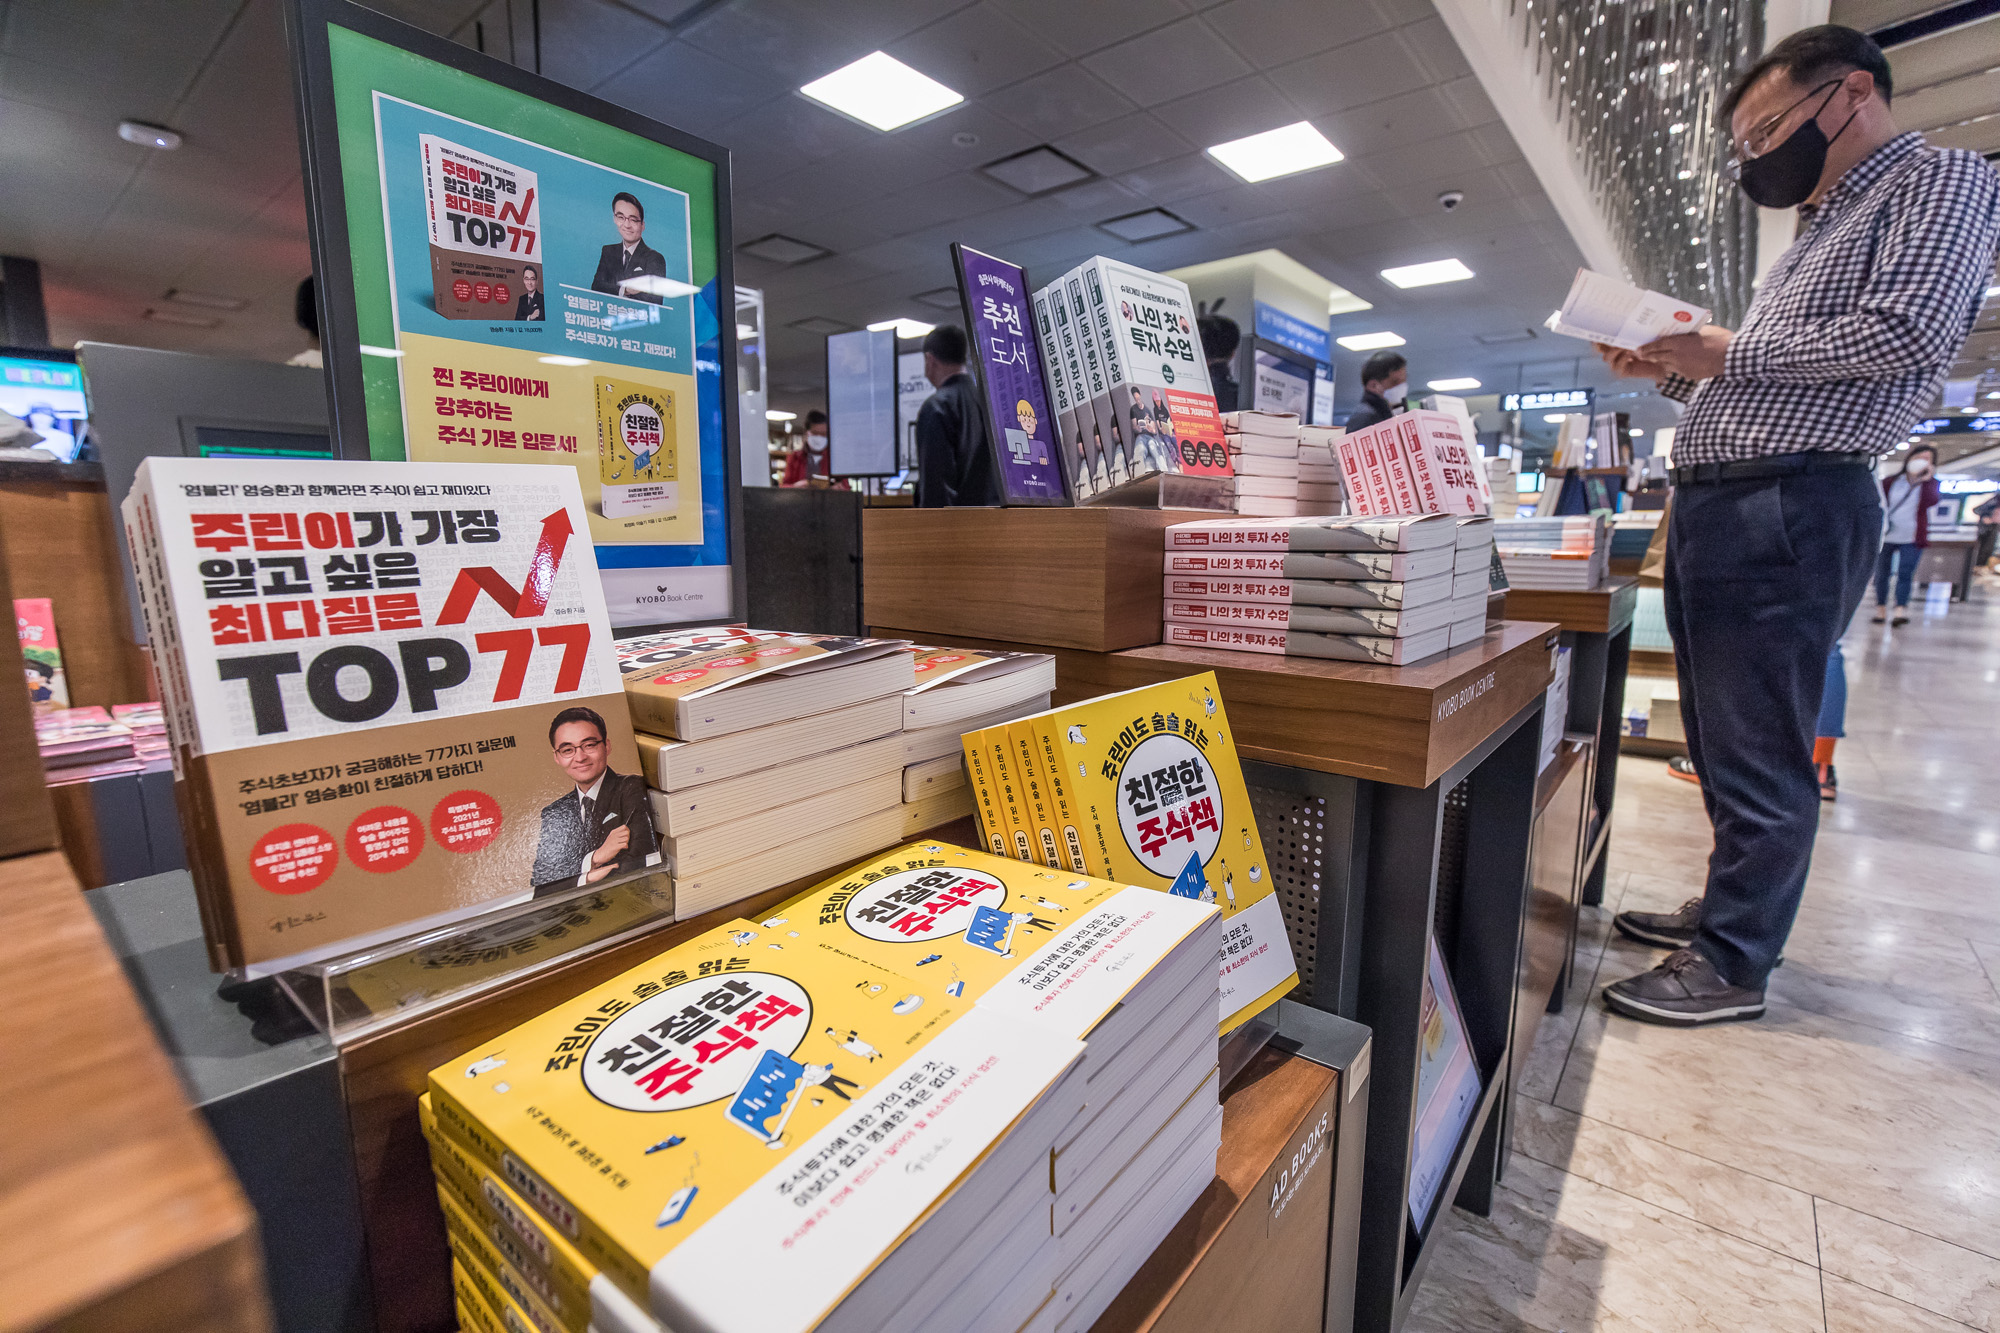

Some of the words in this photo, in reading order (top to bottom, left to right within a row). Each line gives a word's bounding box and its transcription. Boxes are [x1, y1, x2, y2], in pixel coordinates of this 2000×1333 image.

[442, 158, 493, 188] 주린이가
[495, 176, 517, 195] 가장
[443, 176, 470, 197] 알고
[472, 182, 496, 205] 싶은
[444, 193, 495, 219] 최다질문
[983, 296, 1023, 336] 추천
[1097, 306, 1109, 328] 나의
[1133, 303, 1163, 331] 나의
[1163, 311, 1180, 334] 첫
[565, 328, 618, 350] 주식투자가
[621, 338, 641, 353] 쉽고
[991, 336, 1029, 373] 도서
[1045, 335, 1056, 356] 나의
[1105, 340, 1117, 361] 투자
[1130, 327, 1162, 357] 투자
[1164, 336, 1195, 362] 수업
[433, 366, 454, 388] 찐
[460, 370, 549, 399] 주린이에게
[1053, 368, 1064, 389] 투자
[1110, 362, 1122, 384] 수업
[435, 396, 513, 422] 강추하는
[1058, 389, 1068, 409] 수업
[438, 425, 477, 447] 주식
[481, 429, 517, 449] 기본
[521, 432, 578, 453] 입문서!
[625, 413, 659, 432] 친절한
[626, 430, 660, 447] 주식책
[1442, 445, 1462, 464] 나의
[242, 485, 305, 497] 염승환과
[307, 484, 367, 496] 함께라면
[370, 484, 411, 496] 주식이
[413, 485, 439, 496] 쉽고
[441, 485, 491, 496] 재미있다
[1391, 462, 1404, 481] 나의
[1400, 491, 1412, 508] 투자
[1415, 453, 1426, 472] 나의
[1423, 483, 1436, 501] 투자
[1443, 468, 1465, 489] 투자
[190, 511, 403, 553] 주린이가
[410, 510, 501, 545] 가장
[1212, 532, 1232, 543] 나의
[1235, 532, 1245, 543] 첫
[1247, 532, 1268, 544] 투자
[199, 556, 313, 600] 알고
[323, 551, 422, 592] 싶은
[1211, 583, 1230, 594] 나의
[1233, 583, 1243, 595] 첫
[1245, 584, 1266, 596] 투자
[1268, 585, 1290, 597] 수업
[636, 595, 666, 604] KYOBO
[667, 594, 682, 603] Book
[683, 592, 704, 602] Centre
[1210, 607, 1230, 618] 나의
[1232, 607, 1242, 619] 첫
[1244, 608, 1265, 620] 투자
[1268, 609, 1289, 622] 수업
[209, 592, 423, 646] 최다질문
[1437, 693, 1459, 723] KYOBO
[1460, 684, 1475, 709] BOOK
[1475, 671, 1496, 698] CENTRE
[239, 764, 341, 795] 주식초보자가
[345, 753, 422, 774] 궁금해하는
[425, 743, 472, 763] 77가지
[476, 735, 516, 755] 질문에
[1101, 717, 1149, 781] 주린이도
[1152, 712, 1180, 732] 술술
[1184, 718, 1209, 751] 읽는
[304, 782, 370, 805] 염승환이
[374, 771, 433, 793] 친절하게
[436, 759, 484, 779] 답하다!
[1020, 740, 1035, 777] 주린이도
[1030, 781, 1040, 800] 술술
[1035, 803, 1046, 822] 읽는
[1043, 735, 1058, 773] 주린이도
[1053, 777, 1064, 796] 술술
[1059, 800, 1069, 819] 읽는
[1124, 757, 1207, 817] 친절한
[453, 810, 480, 823] 2021년
[1090, 805, 1099, 821] 주식
[1137, 796, 1219, 858] 주식책
[1067, 832, 1084, 869] 친절한
[819, 882, 864, 925] 주린이도
[862, 865, 901, 882] 술술
[905, 859, 946, 870] 읽는
[855, 870, 964, 924] 친절한
[889, 878, 1000, 937] 주식책
[1229, 926, 1242, 940] 모든
[1018, 949, 1061, 985] 주식투자에
[1056, 941, 1076, 954] 대한
[1071, 929, 1091, 942] 거의
[1086, 919, 1106, 930] 모든
[1033, 970, 1061, 991] 이보다
[1057, 957, 1078, 970] 쉽고
[1093, 928, 1113, 939] 책은
[544, 998, 632, 1073] 주린이도
[632, 970, 689, 999] 술술
[698, 957, 750, 976] 읽는
[597, 979, 763, 1076] 친절한
[634, 994, 805, 1101] 주식책
[777, 1137, 849, 1195] 주식투자에
[847, 1114, 877, 1138] 대한
[874, 1092, 902, 1114] 거의
[899, 1073, 926, 1092] 모든
[794, 1169, 840, 1207] 이보다
[839, 1144, 871, 1168] 쉽고
[866, 1110, 909, 1143] 명쾌한
[905, 1088, 934, 1110] 책은
[929, 1066, 960, 1089] 없다!
[1271, 1169, 1288, 1209] AD
[1292, 1111, 1328, 1178] BOOKS
